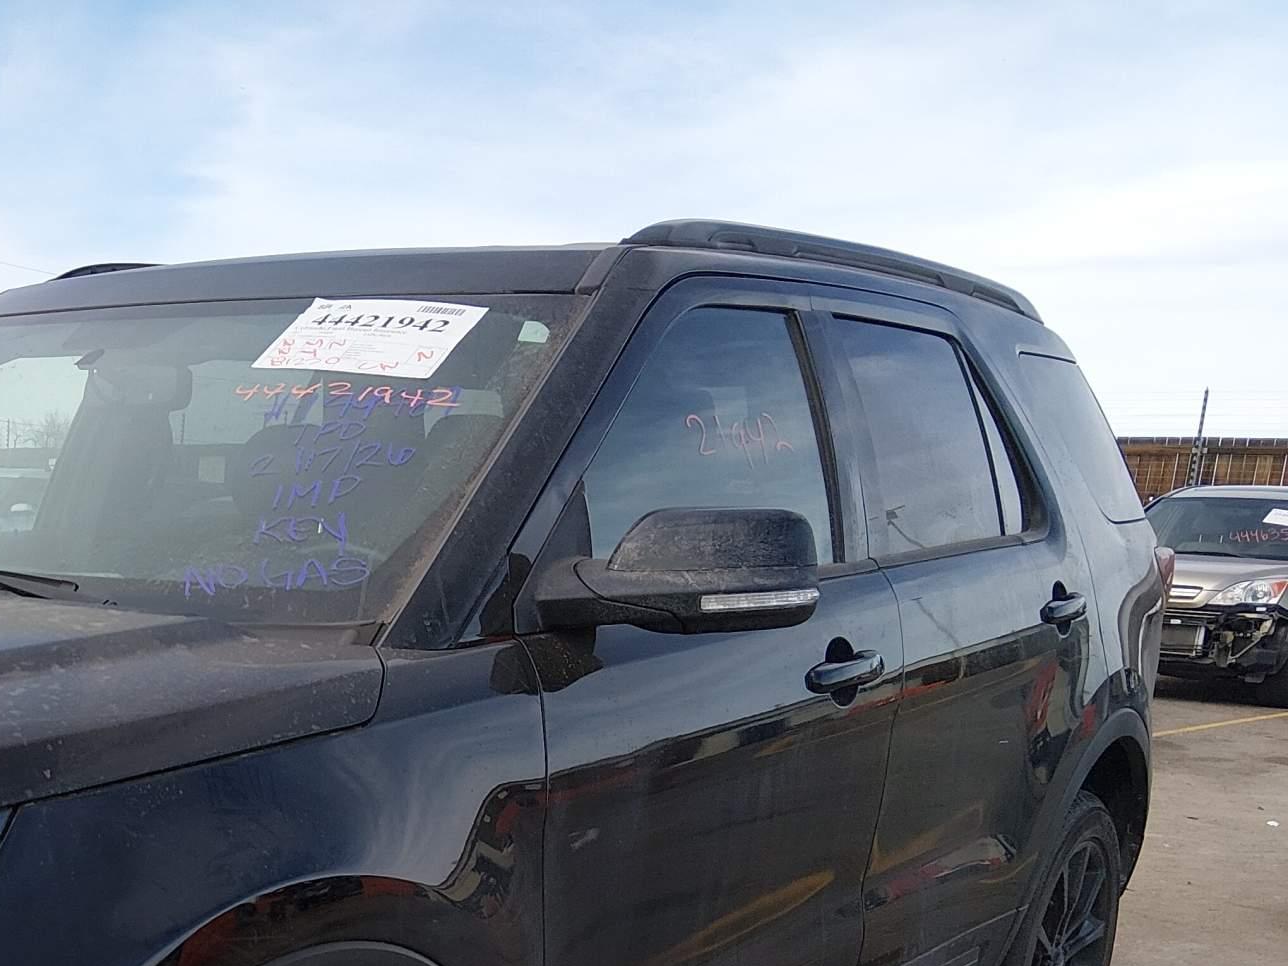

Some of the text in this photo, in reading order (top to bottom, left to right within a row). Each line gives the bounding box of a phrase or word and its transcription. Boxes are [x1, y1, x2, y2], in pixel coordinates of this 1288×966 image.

[311, 312, 451, 334] 44421942
[234, 382, 462, 408] 44421942
[252, 512, 348, 557] KEY
[184, 557, 371, 597] NO GAS
